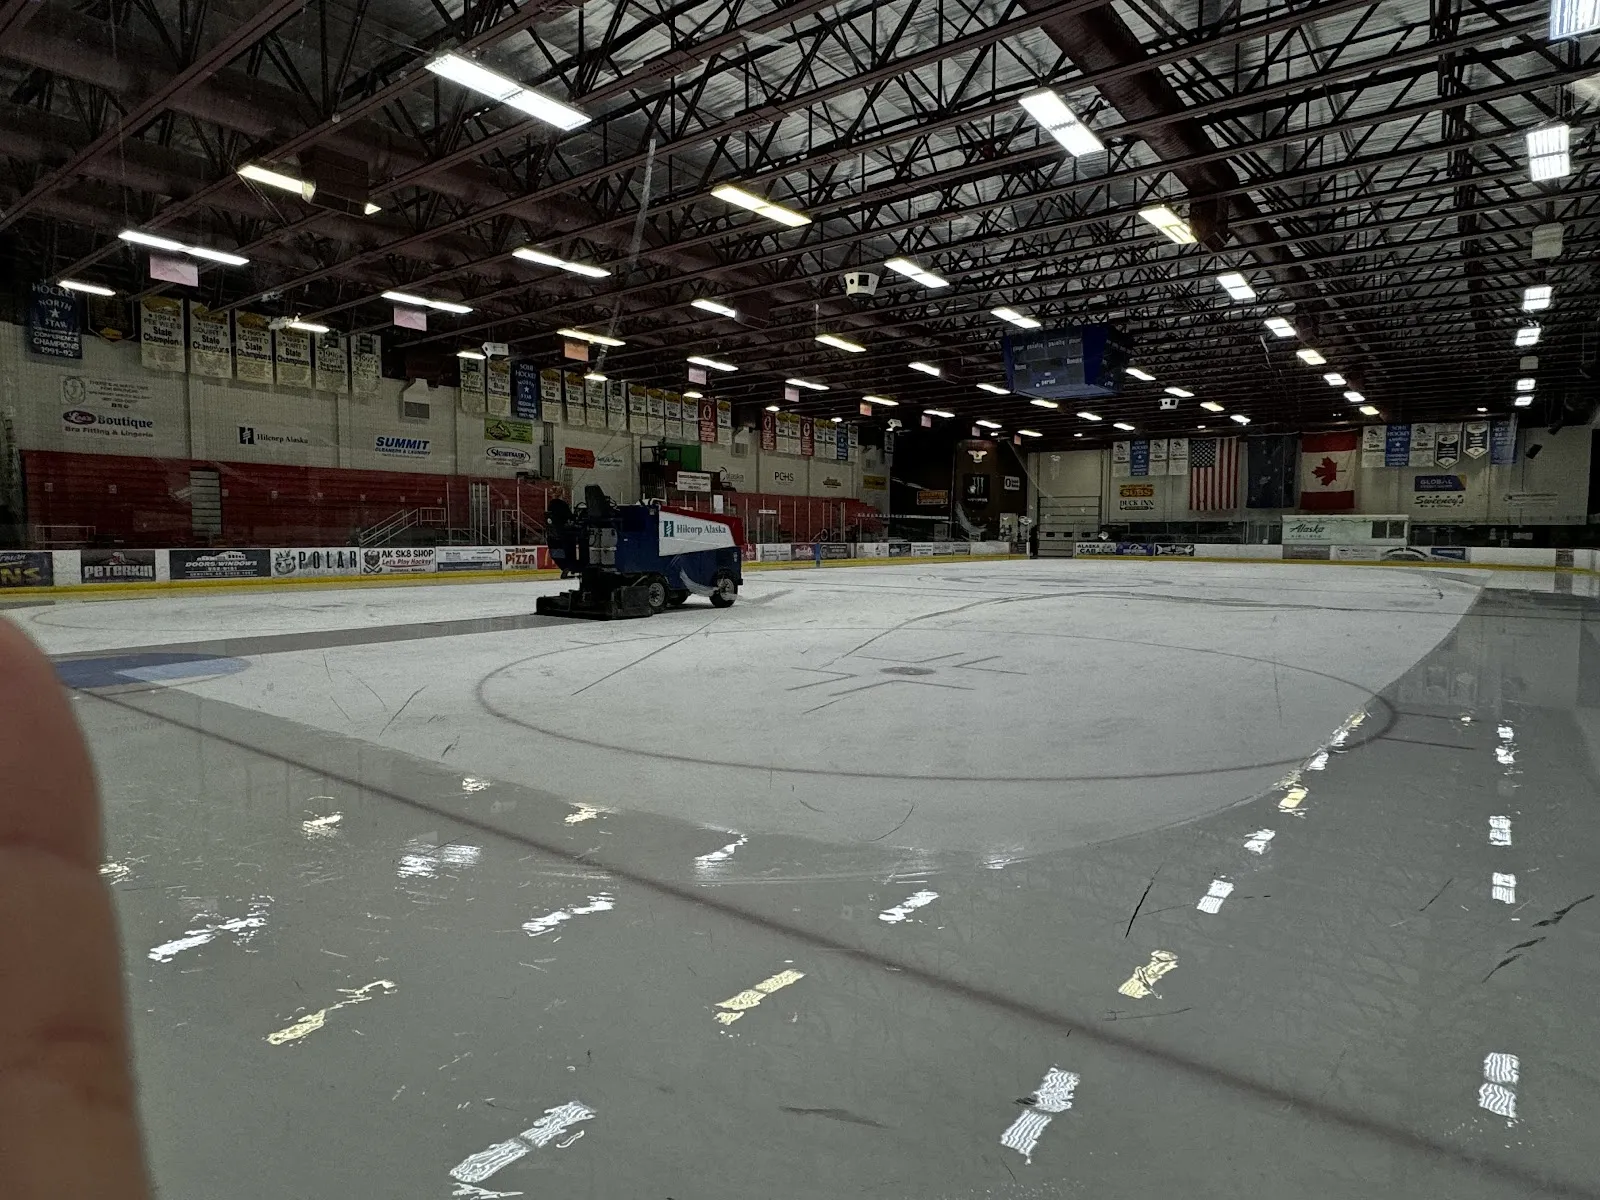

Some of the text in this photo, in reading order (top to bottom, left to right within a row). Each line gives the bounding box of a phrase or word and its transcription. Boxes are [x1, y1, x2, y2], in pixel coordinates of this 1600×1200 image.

[33, 337, 80, 350] CHAMPIONS
[98, 415, 153, 429] Boutique
[375, 437, 430, 450] SUMMIT
[676, 524, 727, 535] Hilcorp Alaska
[1289, 523, 1325, 533] Alaska
[299, 550, 357, 569] POLAR
[381, 550, 393, 558] AK
[395, 549, 412, 558] SK8
[413, 549, 434, 558] SHOP
